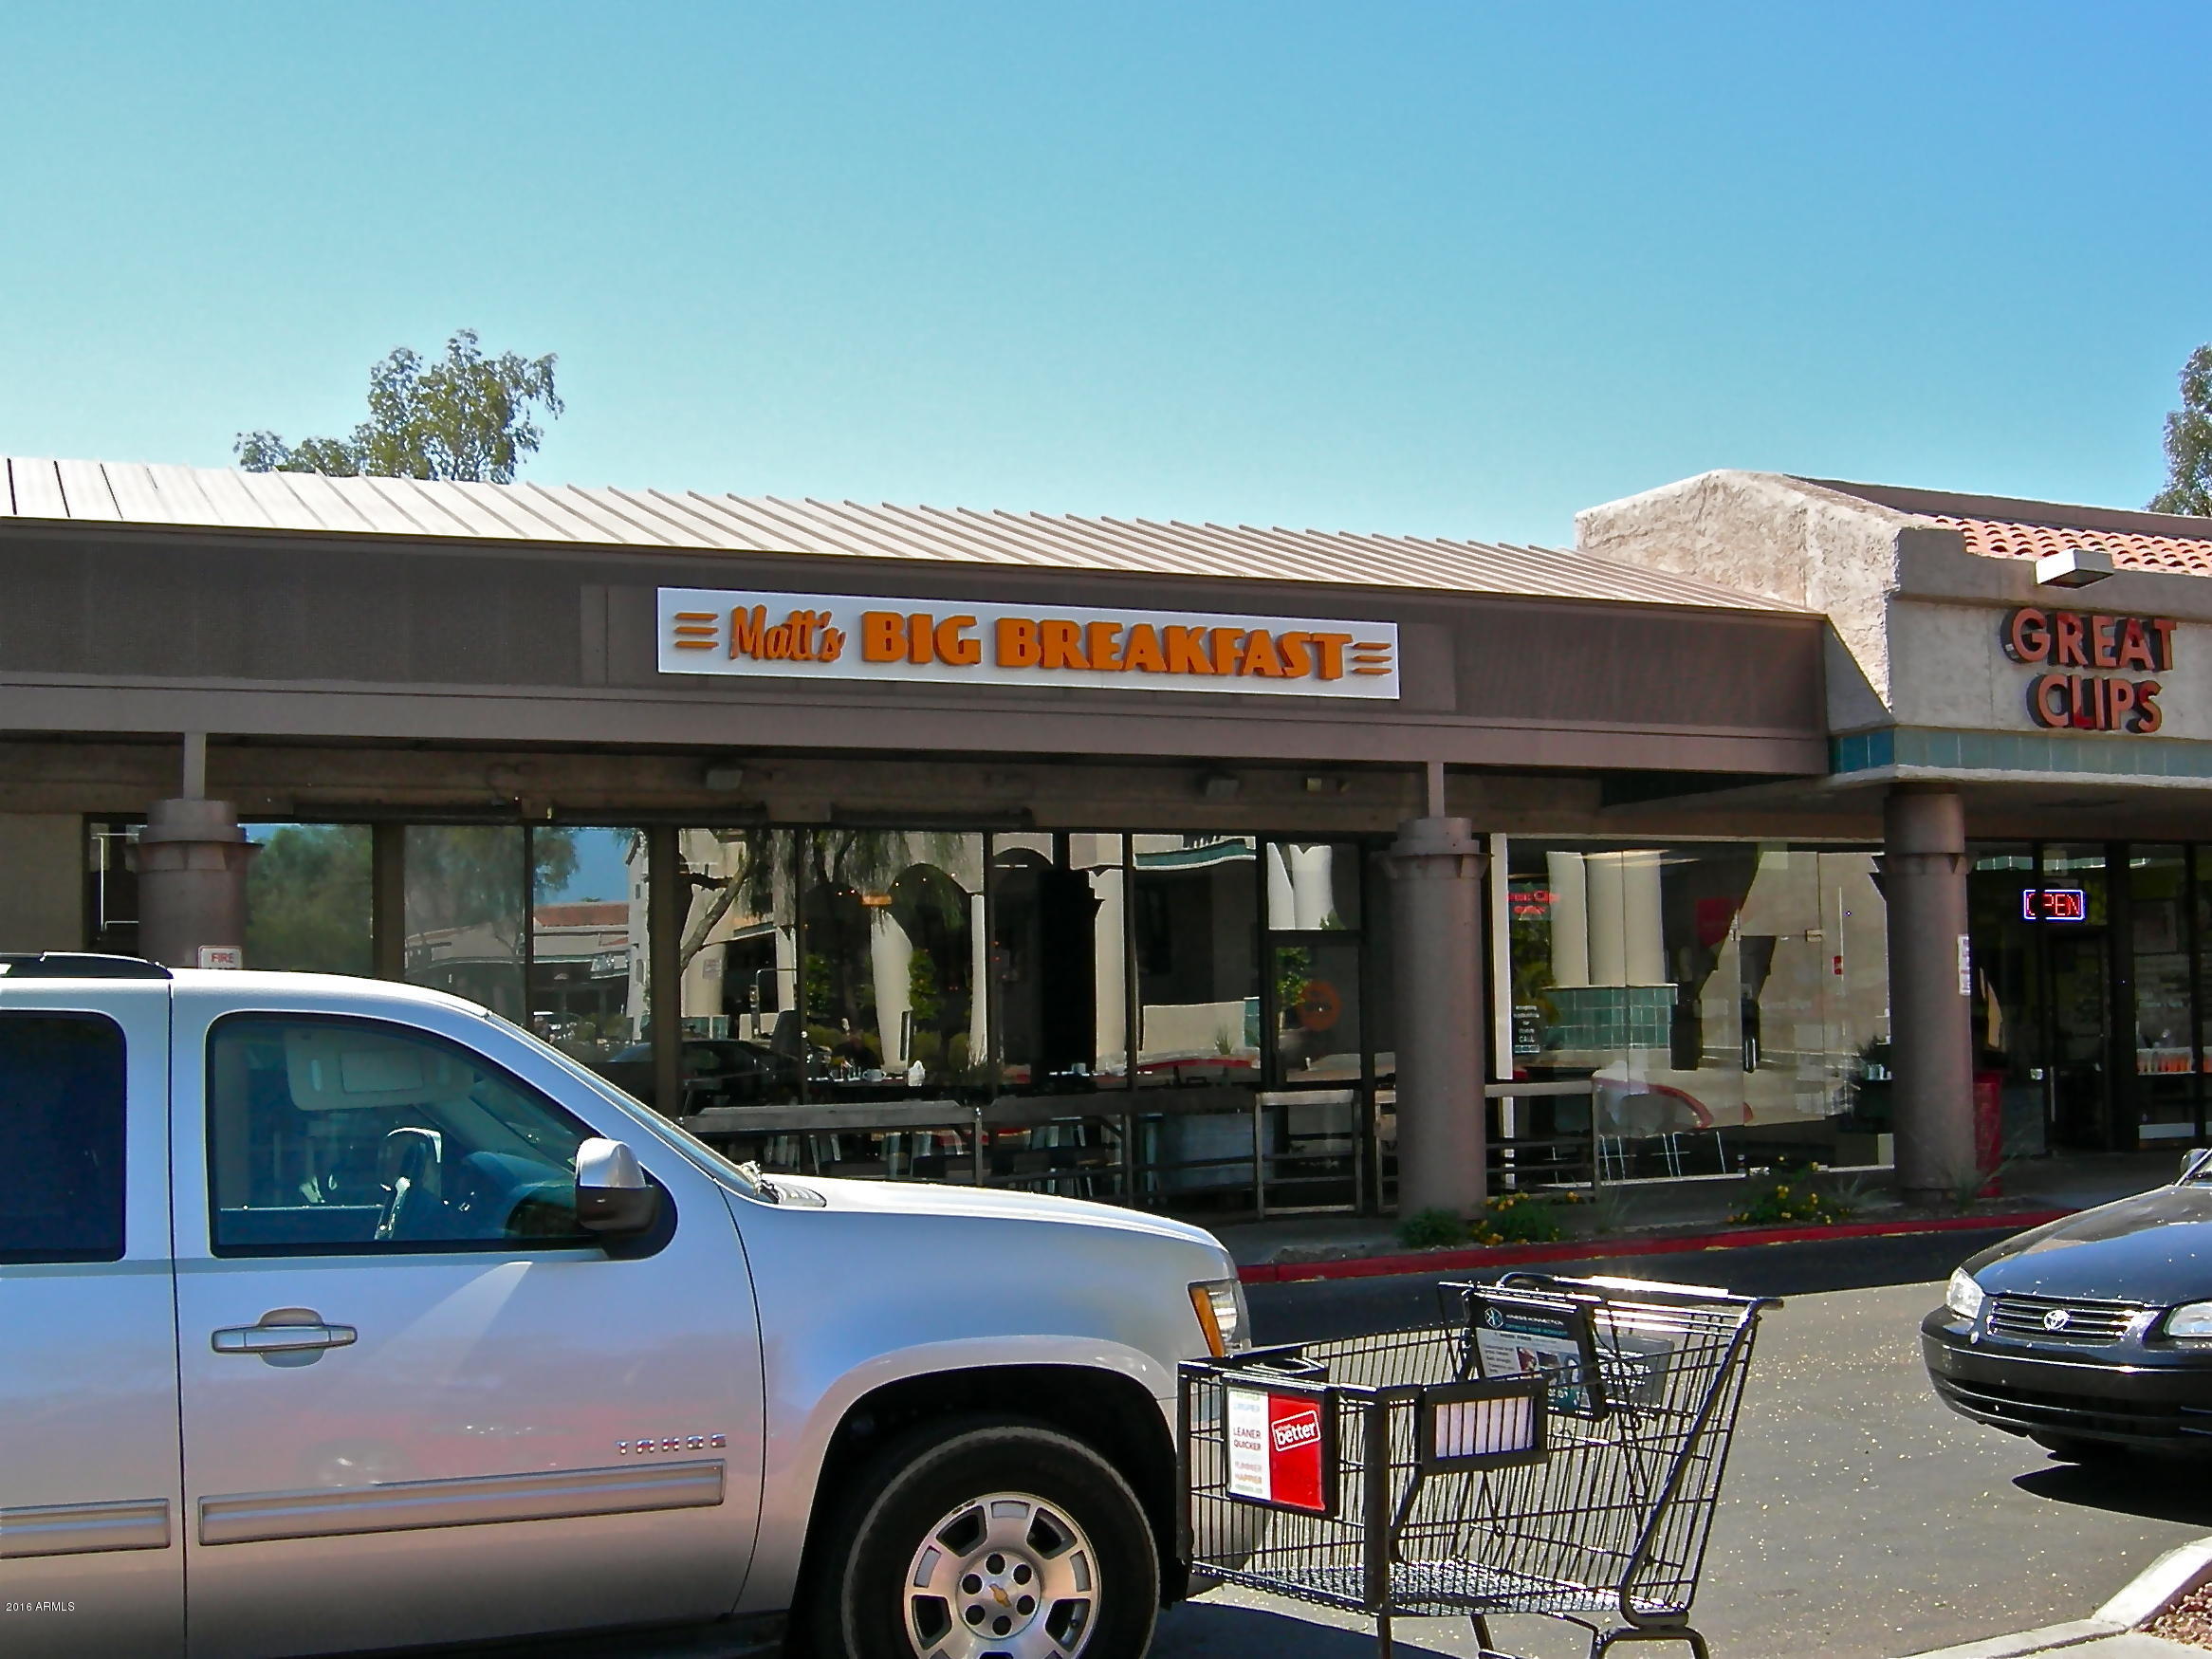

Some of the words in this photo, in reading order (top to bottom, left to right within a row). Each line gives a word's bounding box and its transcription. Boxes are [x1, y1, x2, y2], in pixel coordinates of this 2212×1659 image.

[729, 604, 846, 661] Matt's
[861, 611, 981, 666] BIG
[995, 618, 1352, 680] BREAKFAST
[2001, 608, 2177, 671] GREAT
[2027, 674, 2163, 734] CLIPS
[211, 952, 234, 963] FIRE
[616, 1433, 727, 1454] TAHOE
[1233, 1427, 1262, 1439] LEANER
[1275, 1423, 1316, 1445] better
[1233, 1438, 1262, 1451] QUICKER
